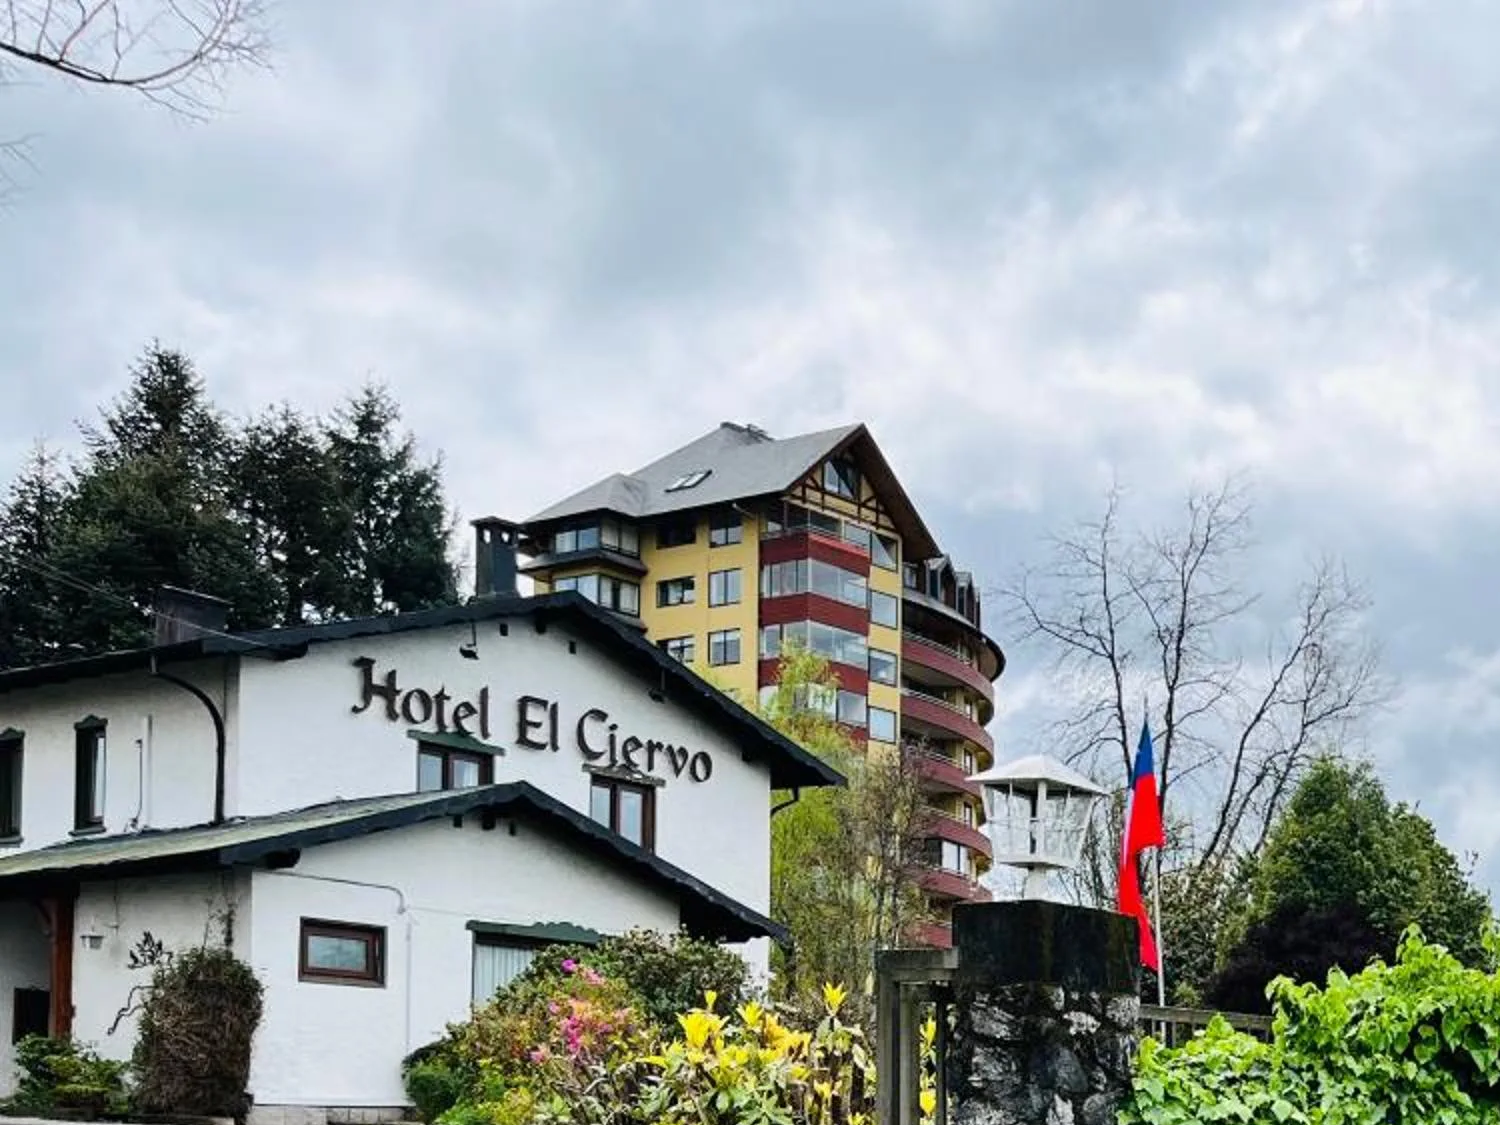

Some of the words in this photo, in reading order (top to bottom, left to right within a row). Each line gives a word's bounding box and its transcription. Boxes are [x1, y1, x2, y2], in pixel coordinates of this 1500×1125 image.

[351, 656, 491, 740] Hotel
[515, 694, 560, 753] El
[576, 708, 713, 783] Ciervo
